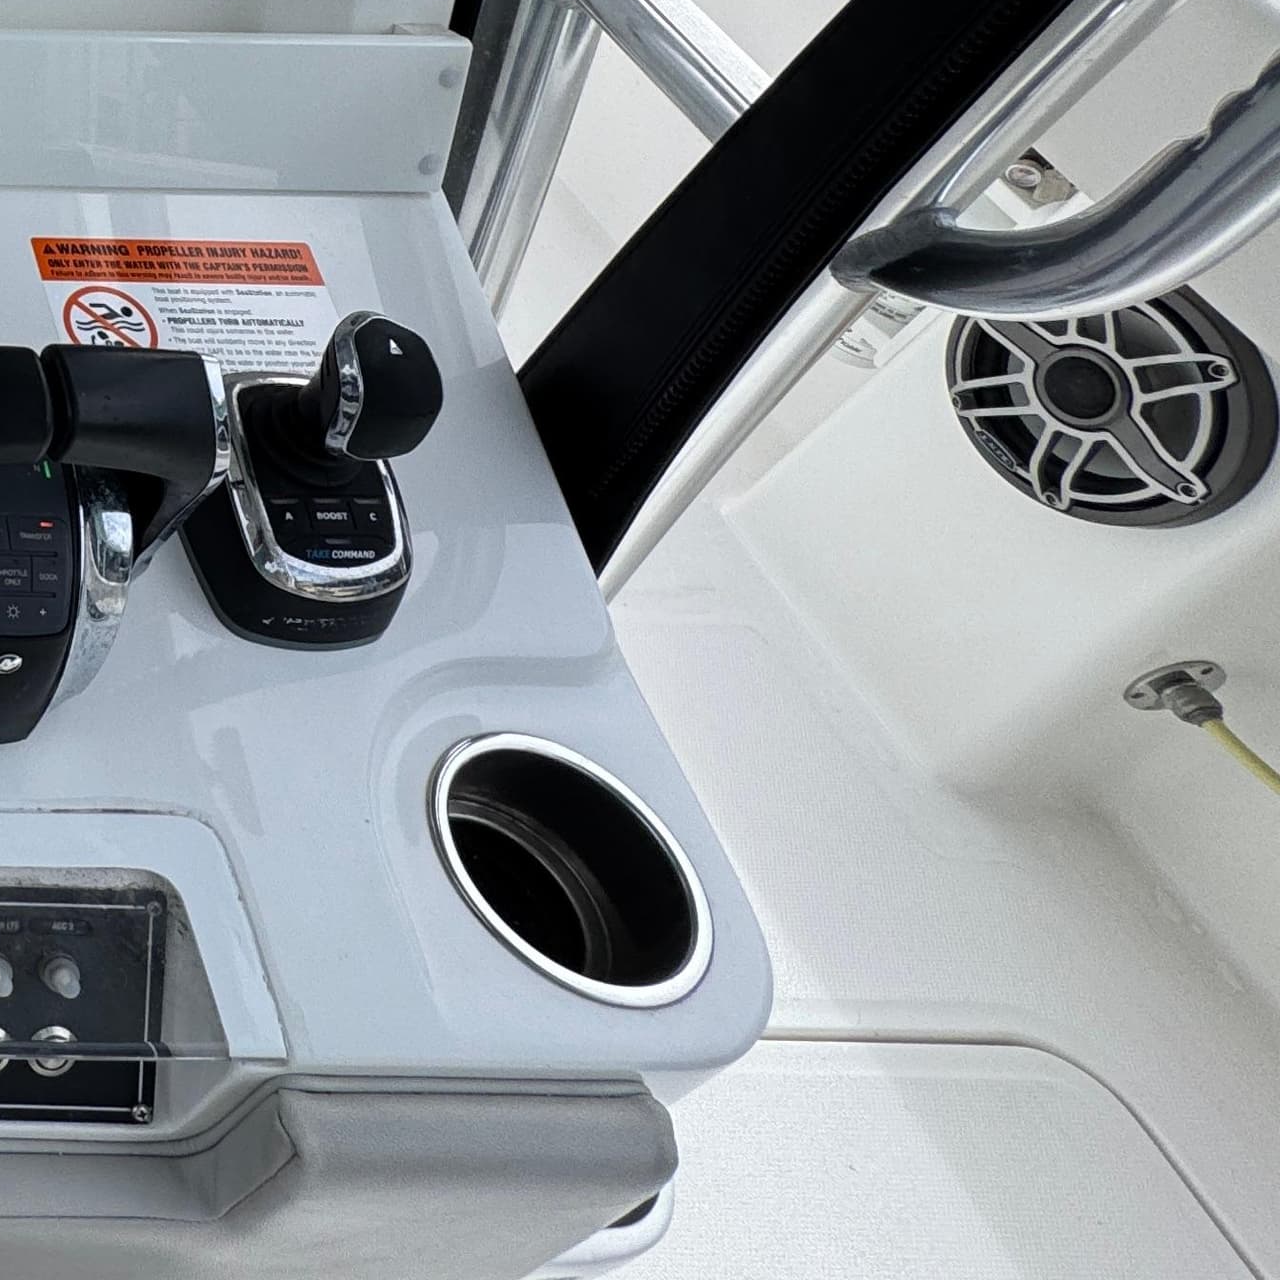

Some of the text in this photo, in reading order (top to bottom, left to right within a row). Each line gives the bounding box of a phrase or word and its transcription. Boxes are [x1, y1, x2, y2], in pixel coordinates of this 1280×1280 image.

[56, 243, 303, 260] WARNING PROPELLER INJURY HAZARD!
[48, 259, 309, 272] ONLY ENTER THE WATER WITH THE CAPTAIN'S PERMISSION
[285, 512, 378, 521] A BOOST C
[306, 549, 376, 560] TAKE COMMAND
[4, 578, 21, 586] ONLY
